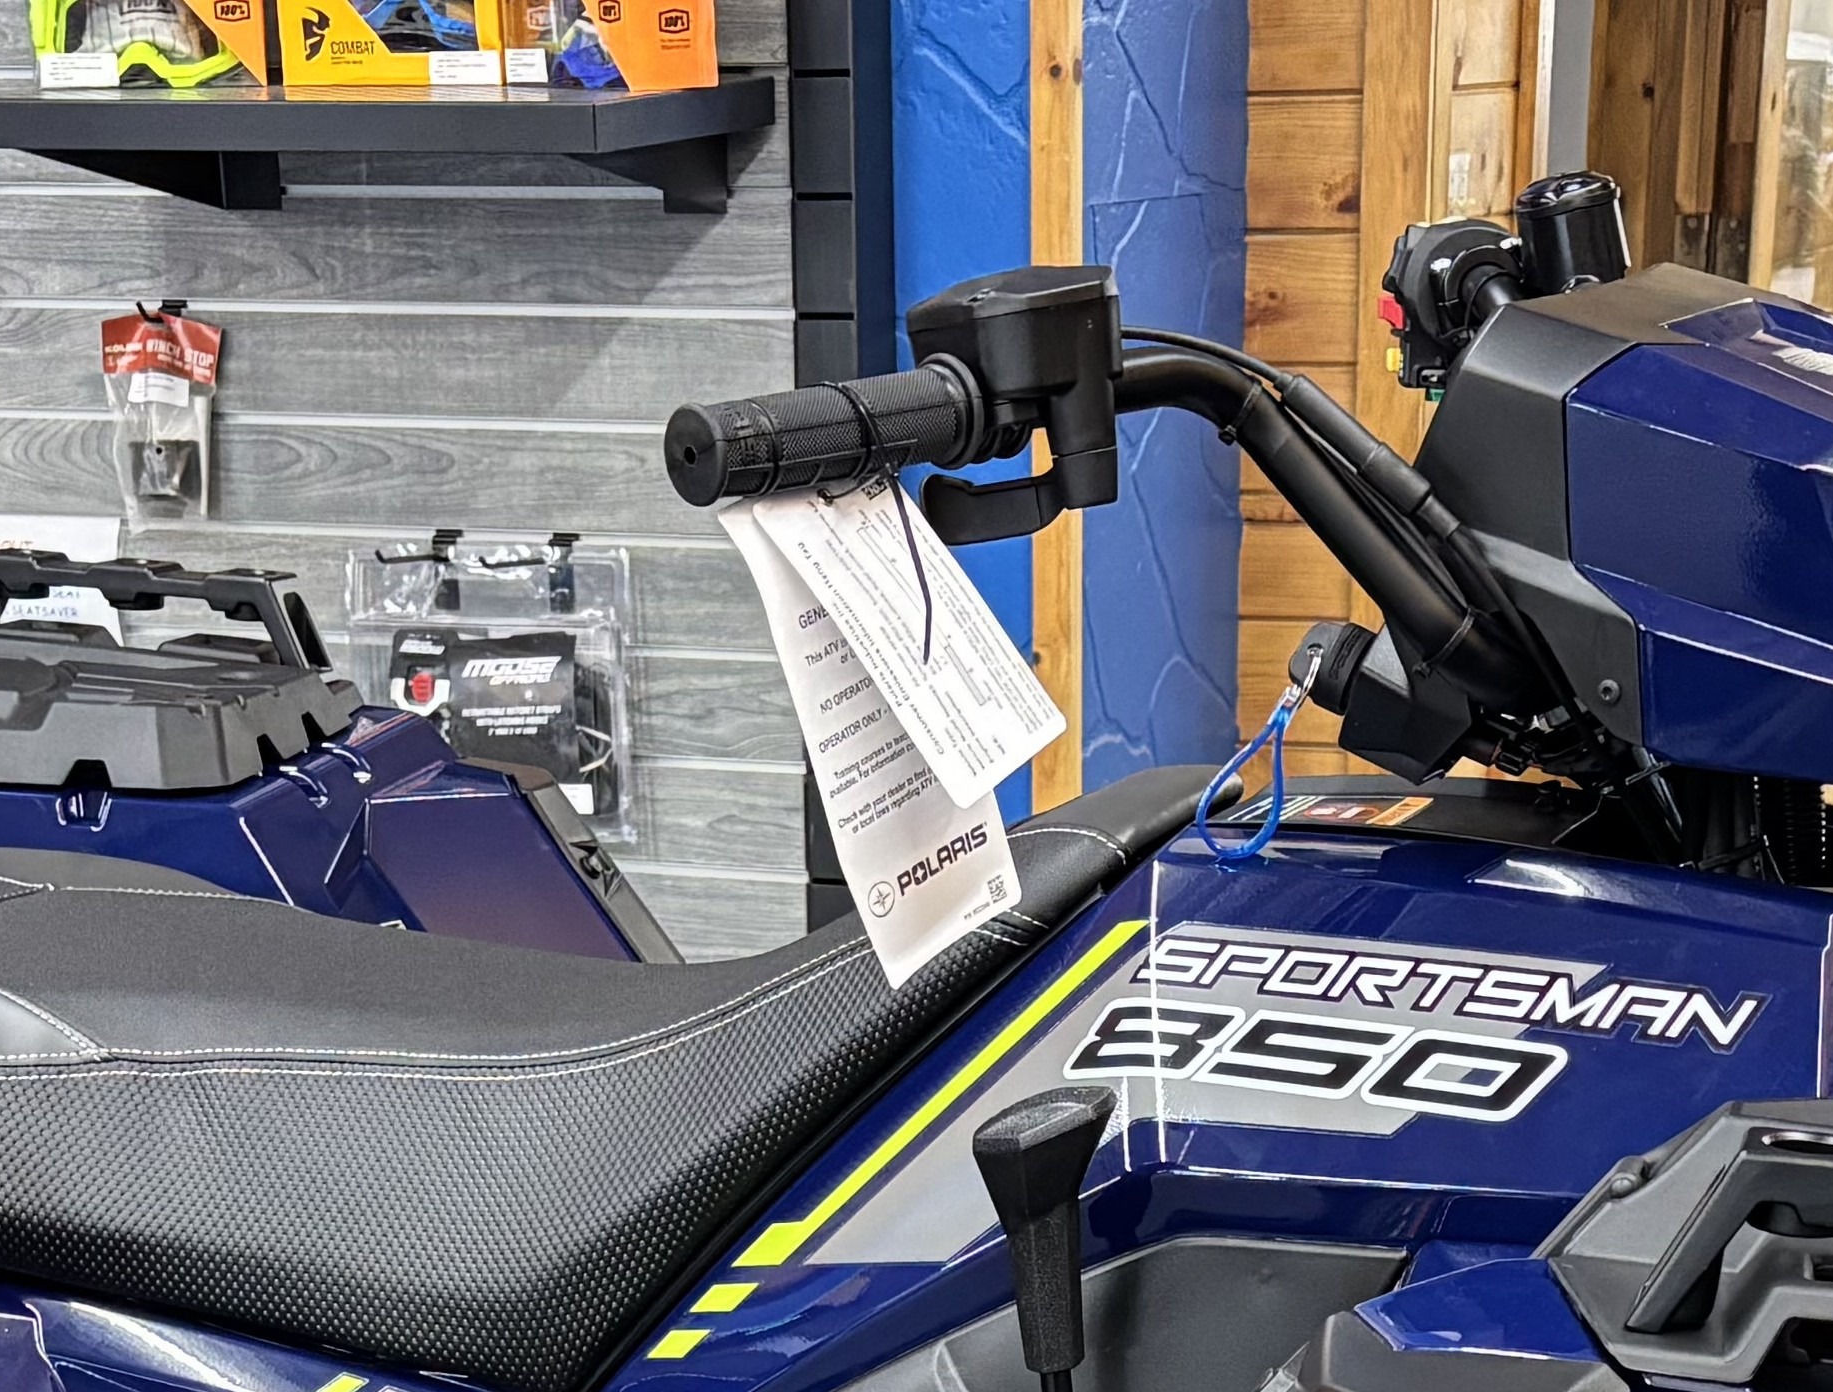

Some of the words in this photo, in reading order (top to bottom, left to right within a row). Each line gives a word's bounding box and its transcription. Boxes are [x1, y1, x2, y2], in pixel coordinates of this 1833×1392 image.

[330, 40, 376, 56] COMBAT
[183, 347, 215, 368] STOP
[804, 649, 823, 667] This
[823, 642, 840, 658] ATV
[820, 697, 833, 714] NO
[834, 676, 874, 707] OPERATO
[818, 723, 862, 754] OPERATOR
[861, 709, 883, 731] ONLY
[834, 761, 861, 781] Training
[860, 747, 885, 767] courses
[869, 748, 907, 775] information
[838, 810, 858, 830] Check
[887, 781, 907, 801] dealer
[890, 786, 921, 813] regarding
[896, 822, 988, 897] POLARIS
[1137, 938, 1762, 1050] SPORTSMAN
[1061, 997, 1569, 1123] 850
